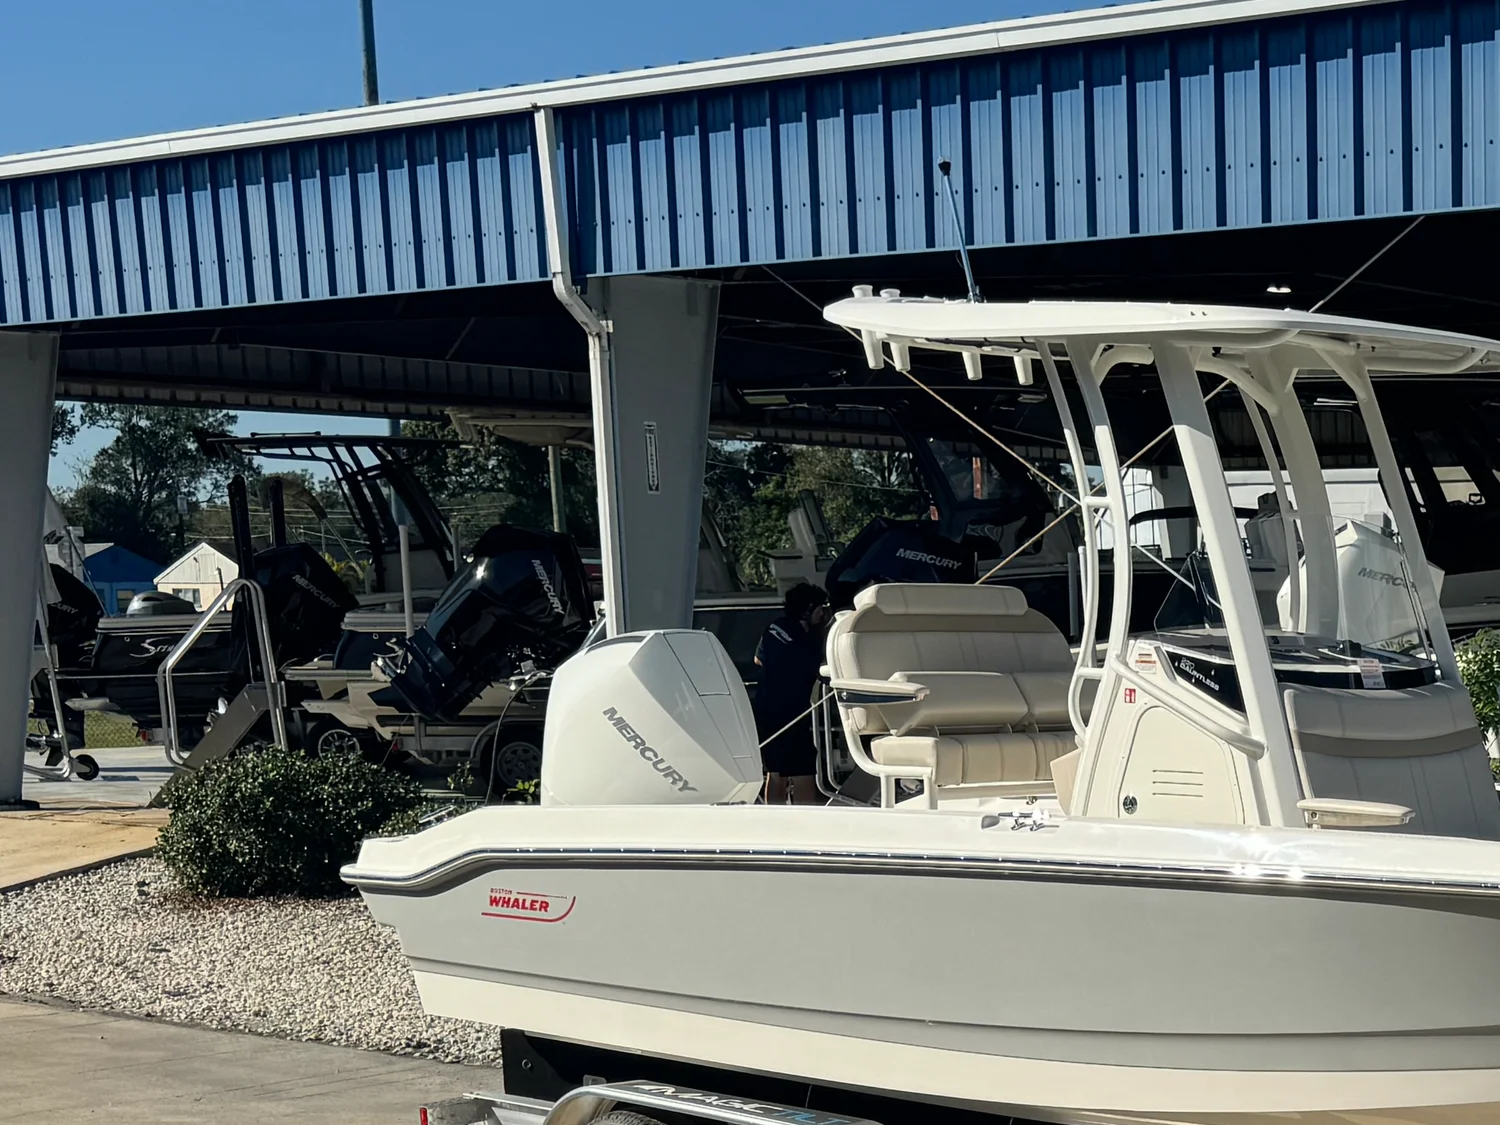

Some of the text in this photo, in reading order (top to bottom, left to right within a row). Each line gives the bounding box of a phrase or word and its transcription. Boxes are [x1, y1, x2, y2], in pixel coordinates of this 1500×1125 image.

[896, 548, 962, 570] MERCURY
[531, 560, 565, 614] MERCURY
[1358, 567, 1412, 588] MERC
[1179, 663, 1220, 691] DAUNTLESS
[602, 706, 699, 792] MERCURY
[489, 895, 549, 912] WHALER
